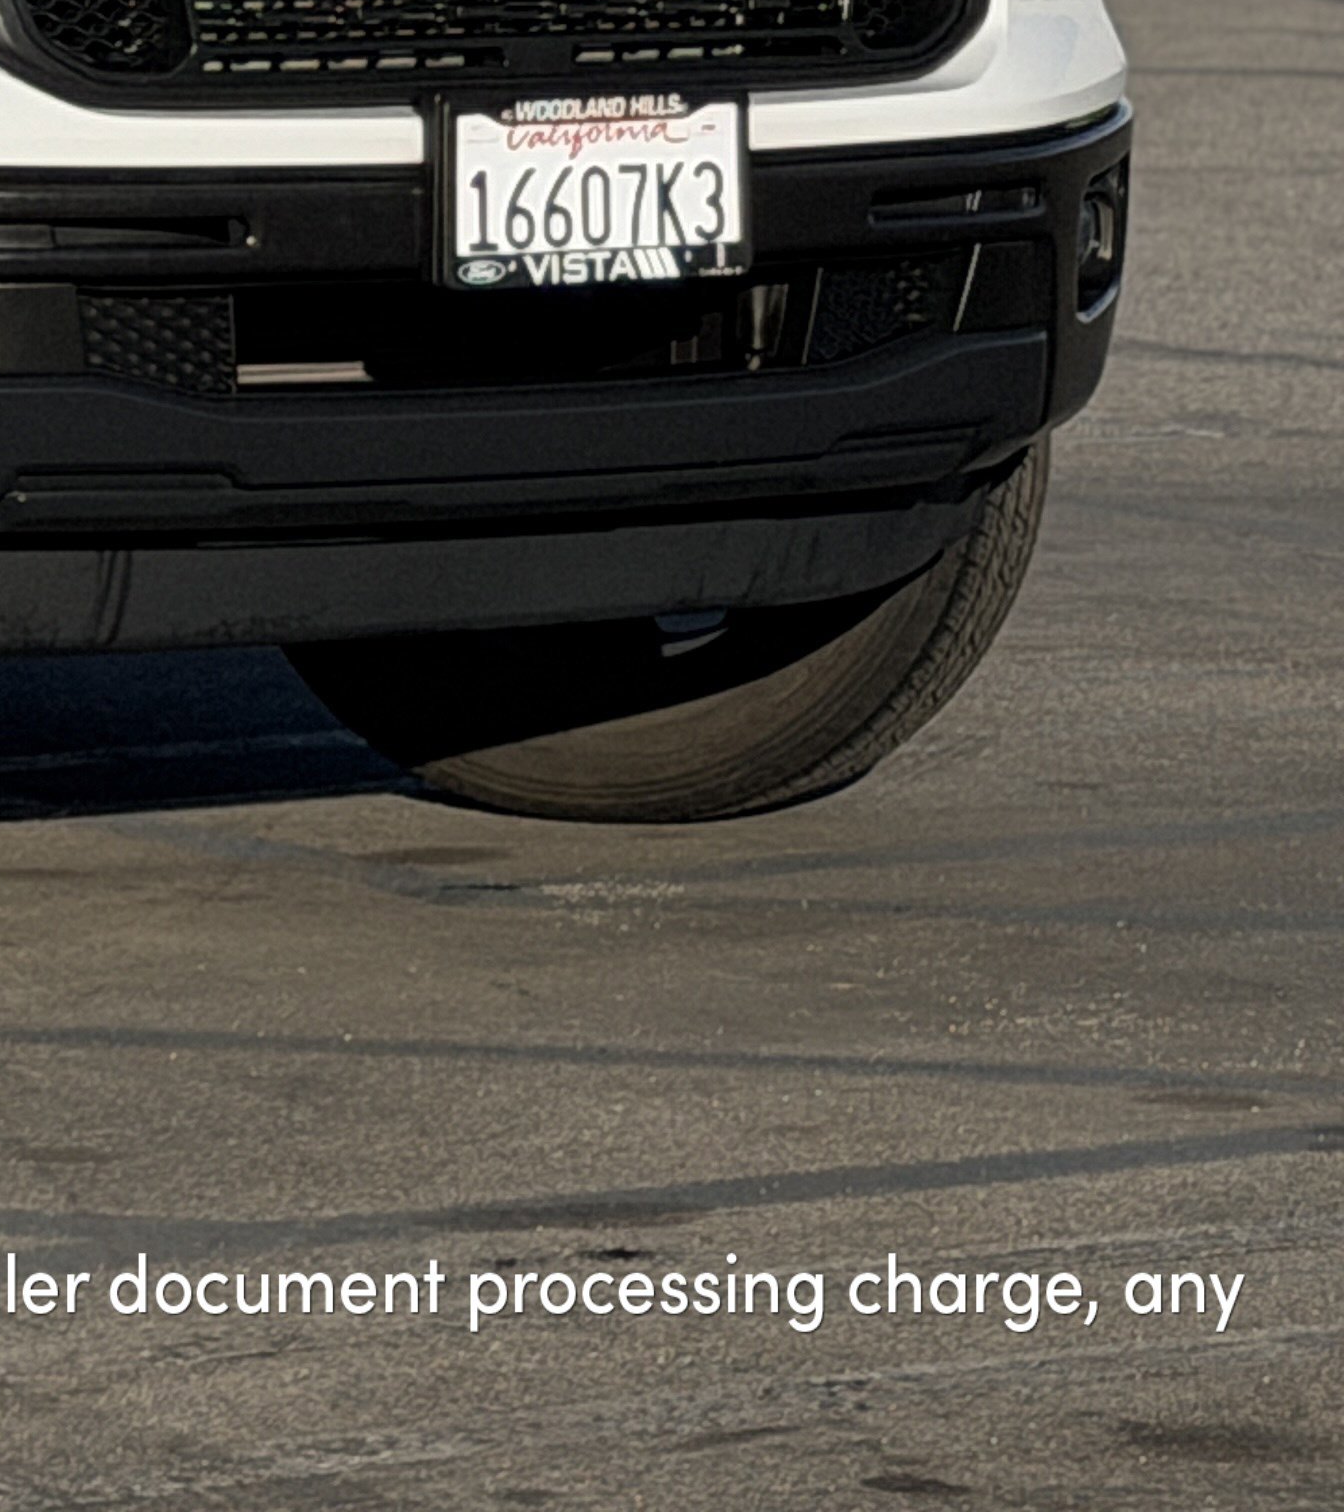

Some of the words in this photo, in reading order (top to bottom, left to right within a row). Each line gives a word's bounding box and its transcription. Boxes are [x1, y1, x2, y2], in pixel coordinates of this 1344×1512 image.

[514, 96, 626, 122] WOODLAND
[629, 92, 683, 118] HILLS
[506, 121, 689, 160] California
[468, 160, 725, 253] 16607K3
[524, 249, 637, 286] VISTA
